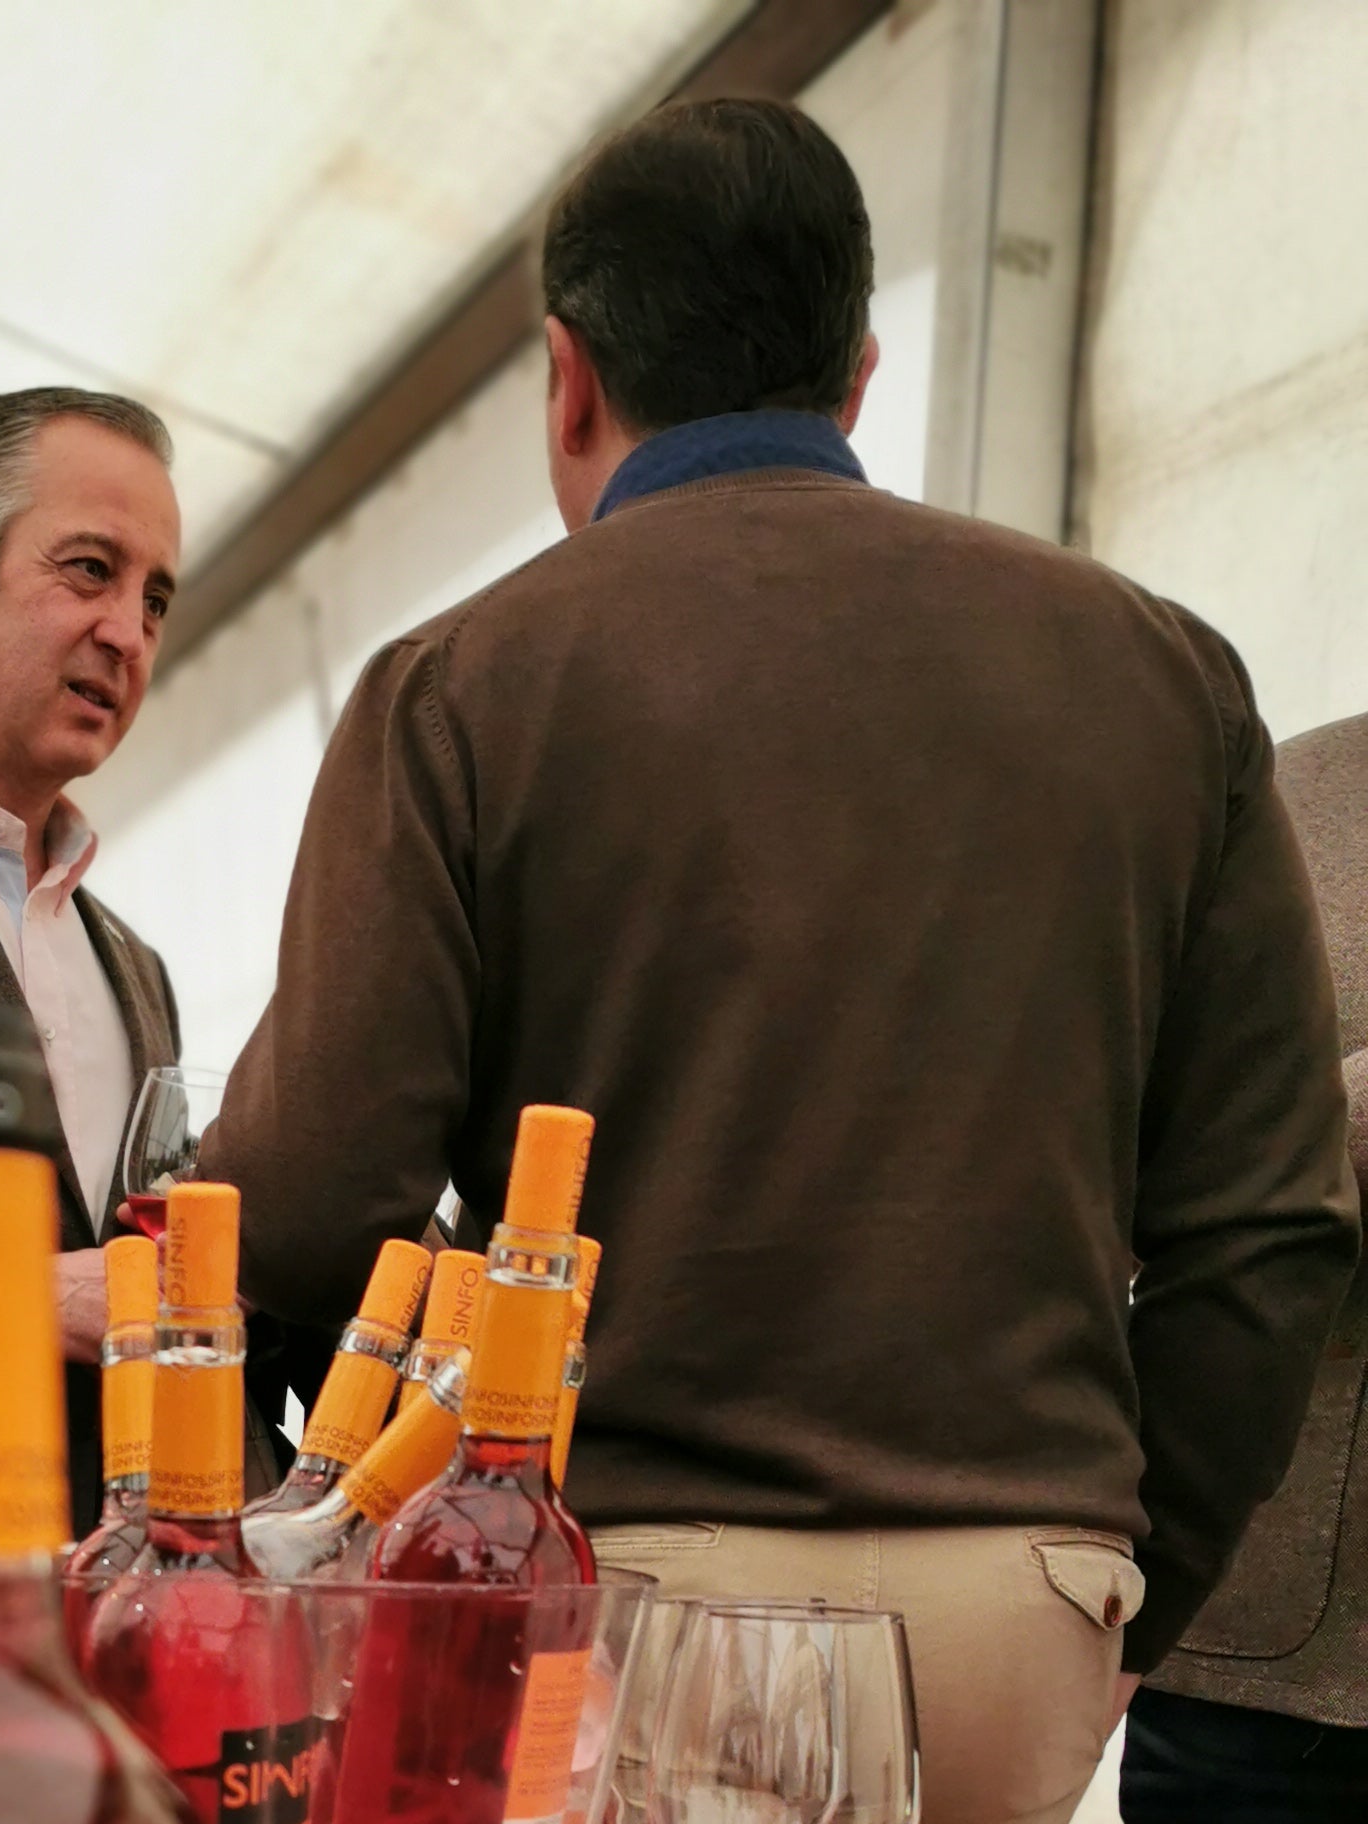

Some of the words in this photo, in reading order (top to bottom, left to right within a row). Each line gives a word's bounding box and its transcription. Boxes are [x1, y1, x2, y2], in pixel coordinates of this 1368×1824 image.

[170, 1217, 188, 1305] SINFO
[400, 1265, 428, 1327] SINFO
[449, 1267, 479, 1338] SINFO
